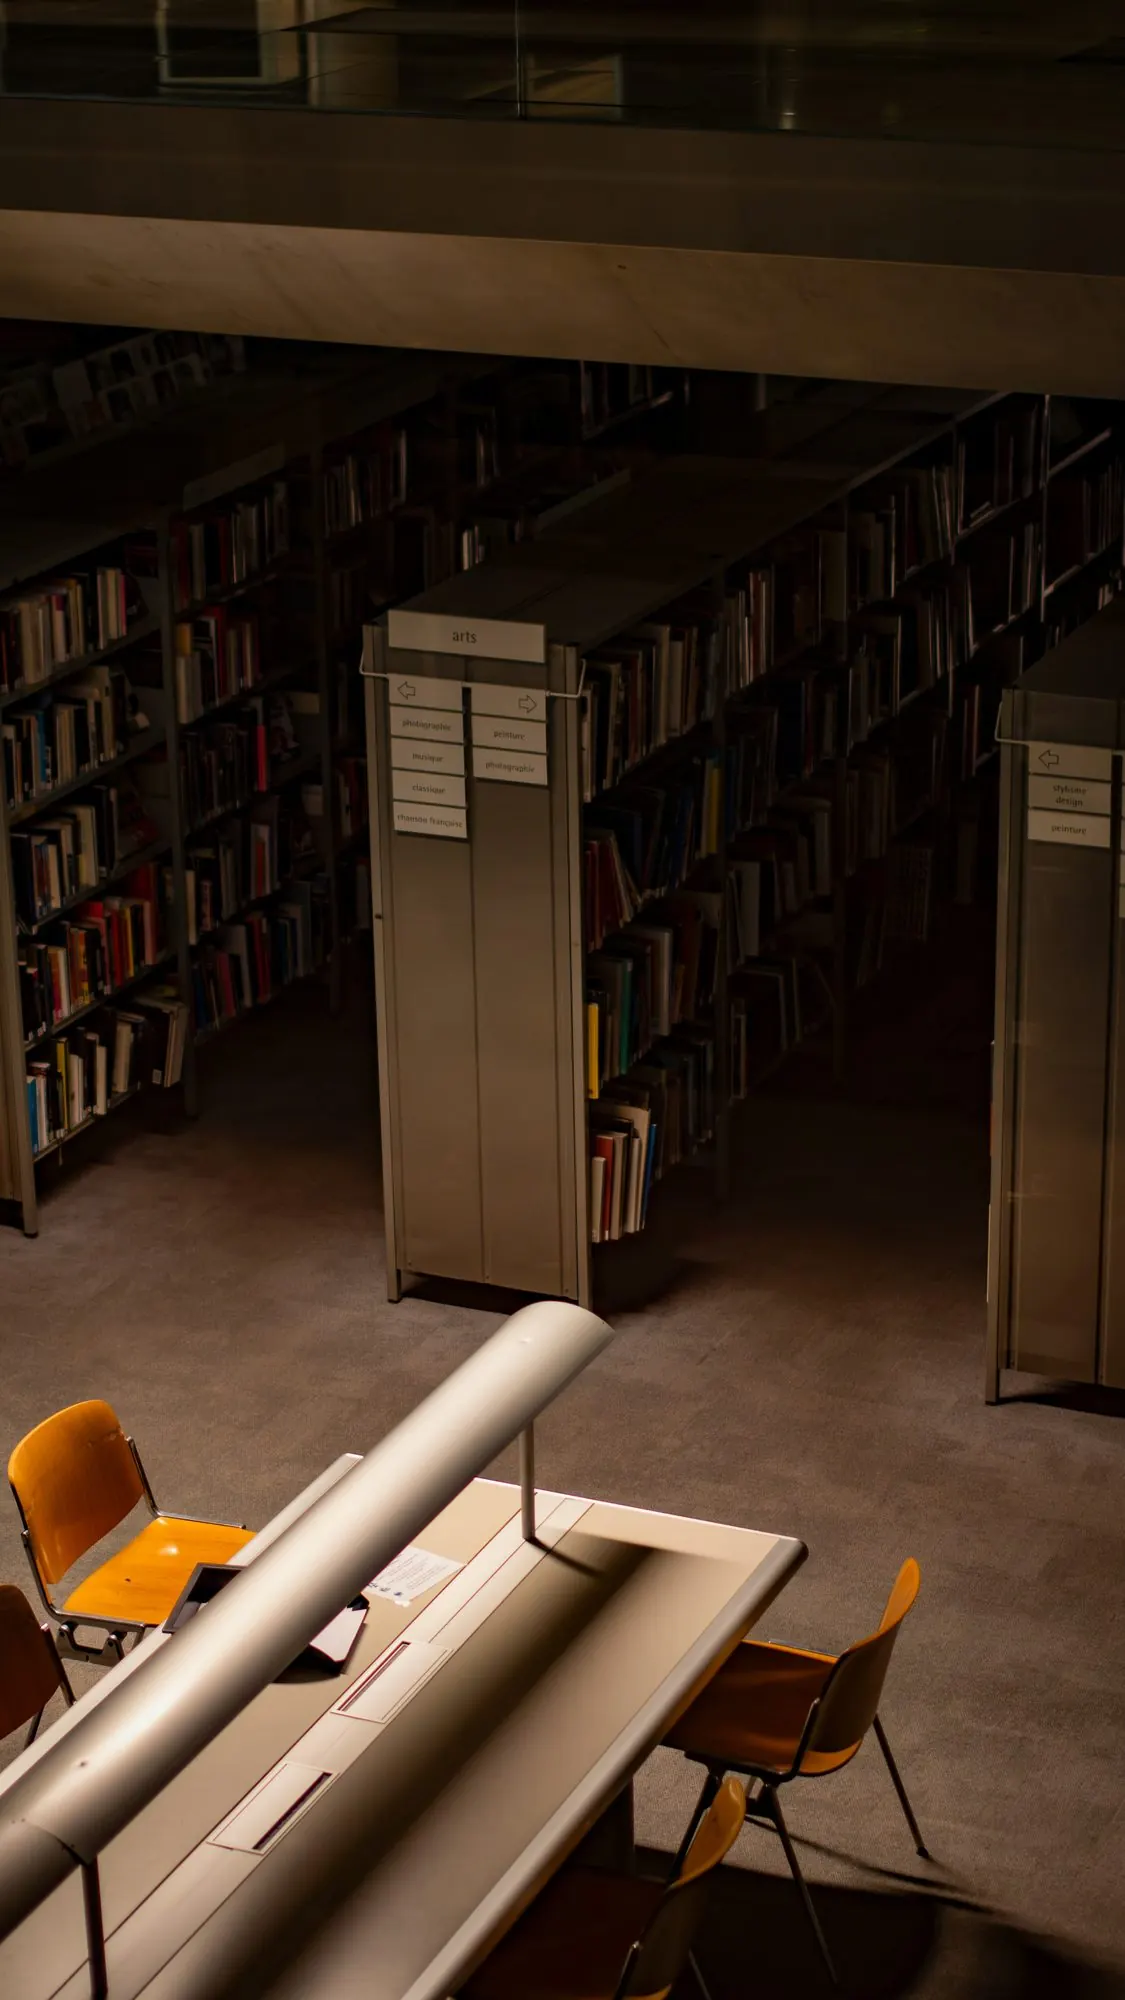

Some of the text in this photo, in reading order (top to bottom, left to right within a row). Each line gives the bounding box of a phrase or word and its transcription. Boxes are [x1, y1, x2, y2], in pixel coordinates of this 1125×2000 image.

[452, 631, 477, 644] arts
[402, 718, 451, 732] photographie
[493, 729, 526, 741] peinture
[412, 752, 444, 764] musique
[485, 761, 536, 774] photographie
[412, 784, 446, 795] classique
[1053, 784, 1087, 796] stylisme
[1055, 796, 1083, 808] design
[397, 814, 463, 829] chanson française
[1051, 824, 1087, 835] peinture
